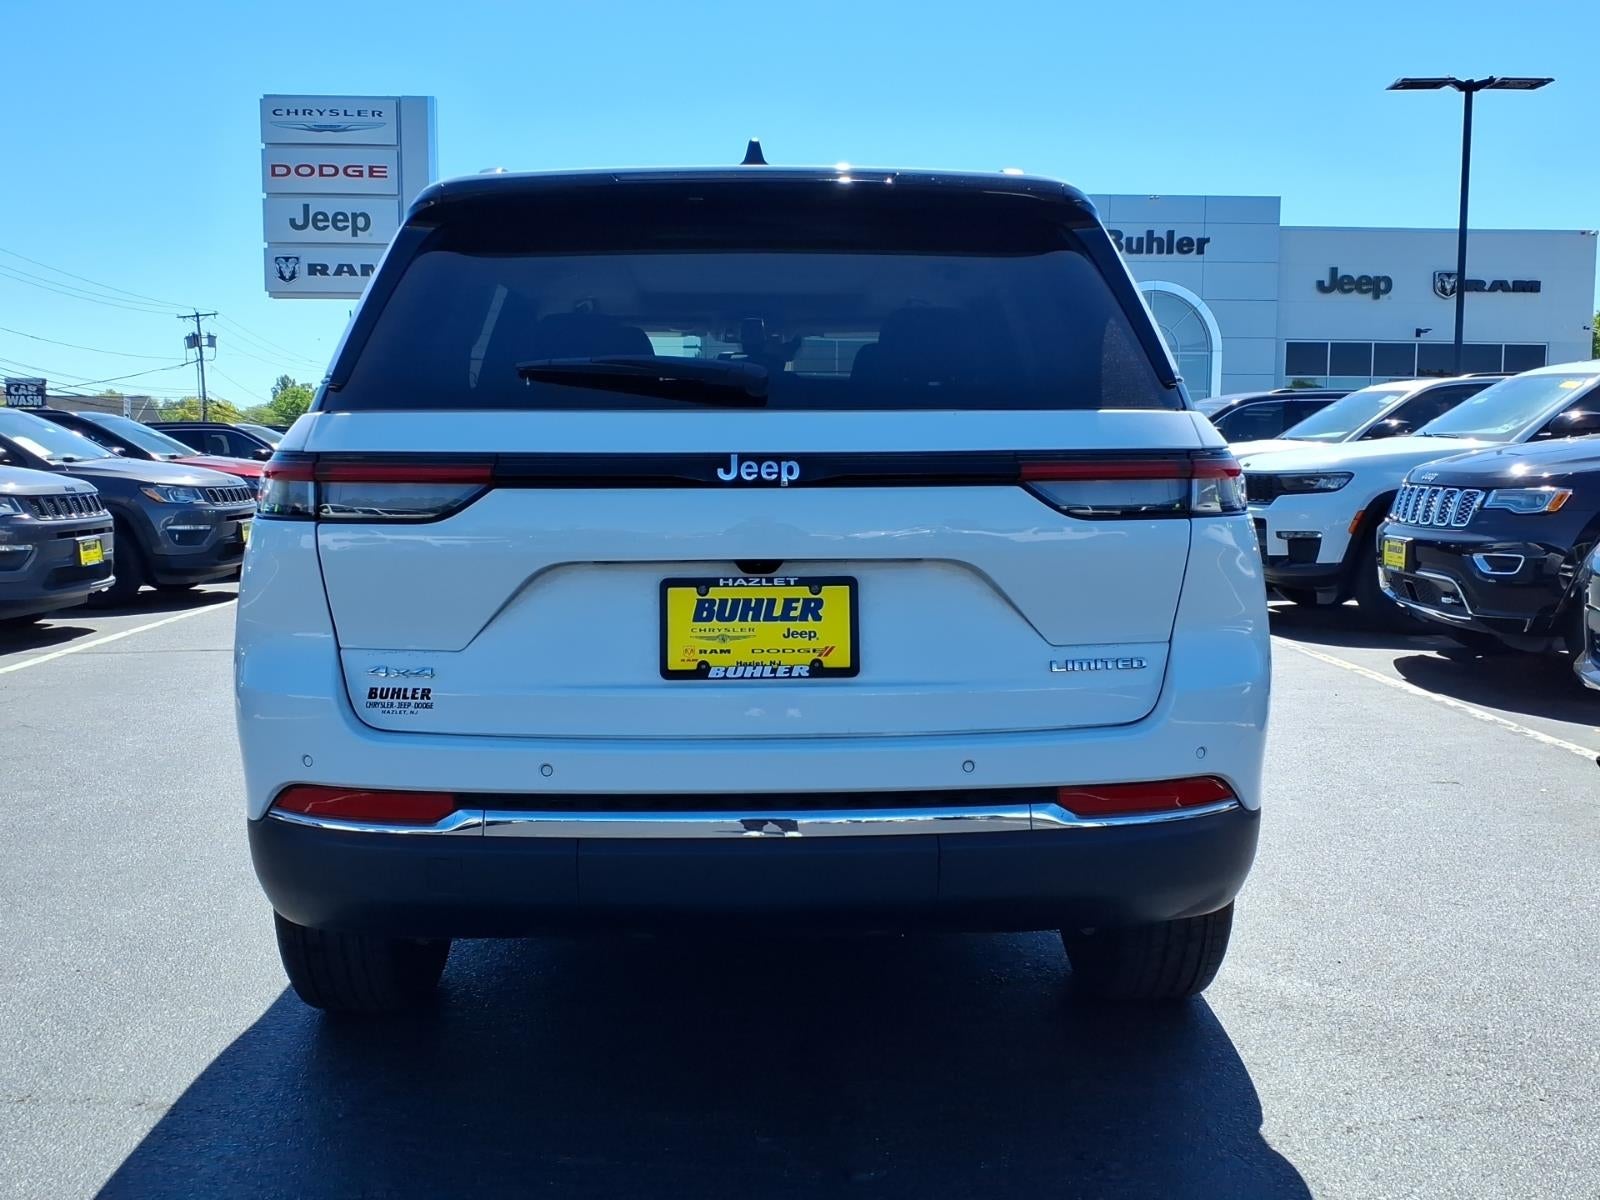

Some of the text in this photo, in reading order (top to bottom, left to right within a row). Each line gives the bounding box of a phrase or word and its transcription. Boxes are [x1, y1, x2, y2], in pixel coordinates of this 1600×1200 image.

[272, 108, 384, 118] CHRYSLER
[270, 163, 389, 179] DODGE
[288, 203, 371, 238] Jeep
[1316, 266, 1393, 300] Jeep
[1464, 279, 1542, 293] RAM
[10, 384, 38, 396] CAR
[7, 395, 43, 406] WASH
[717, 454, 800, 487] Jeep
[719, 577, 799, 587] HAZLET
[692, 597, 825, 623] BUHLER
[782, 628, 816, 640] Jeep
[367, 666, 435, 678] 4x4
[708, 665, 811, 679] BUHLER
[1050, 658, 1148, 672] LIMITED
[367, 687, 432, 700] BUHLER
